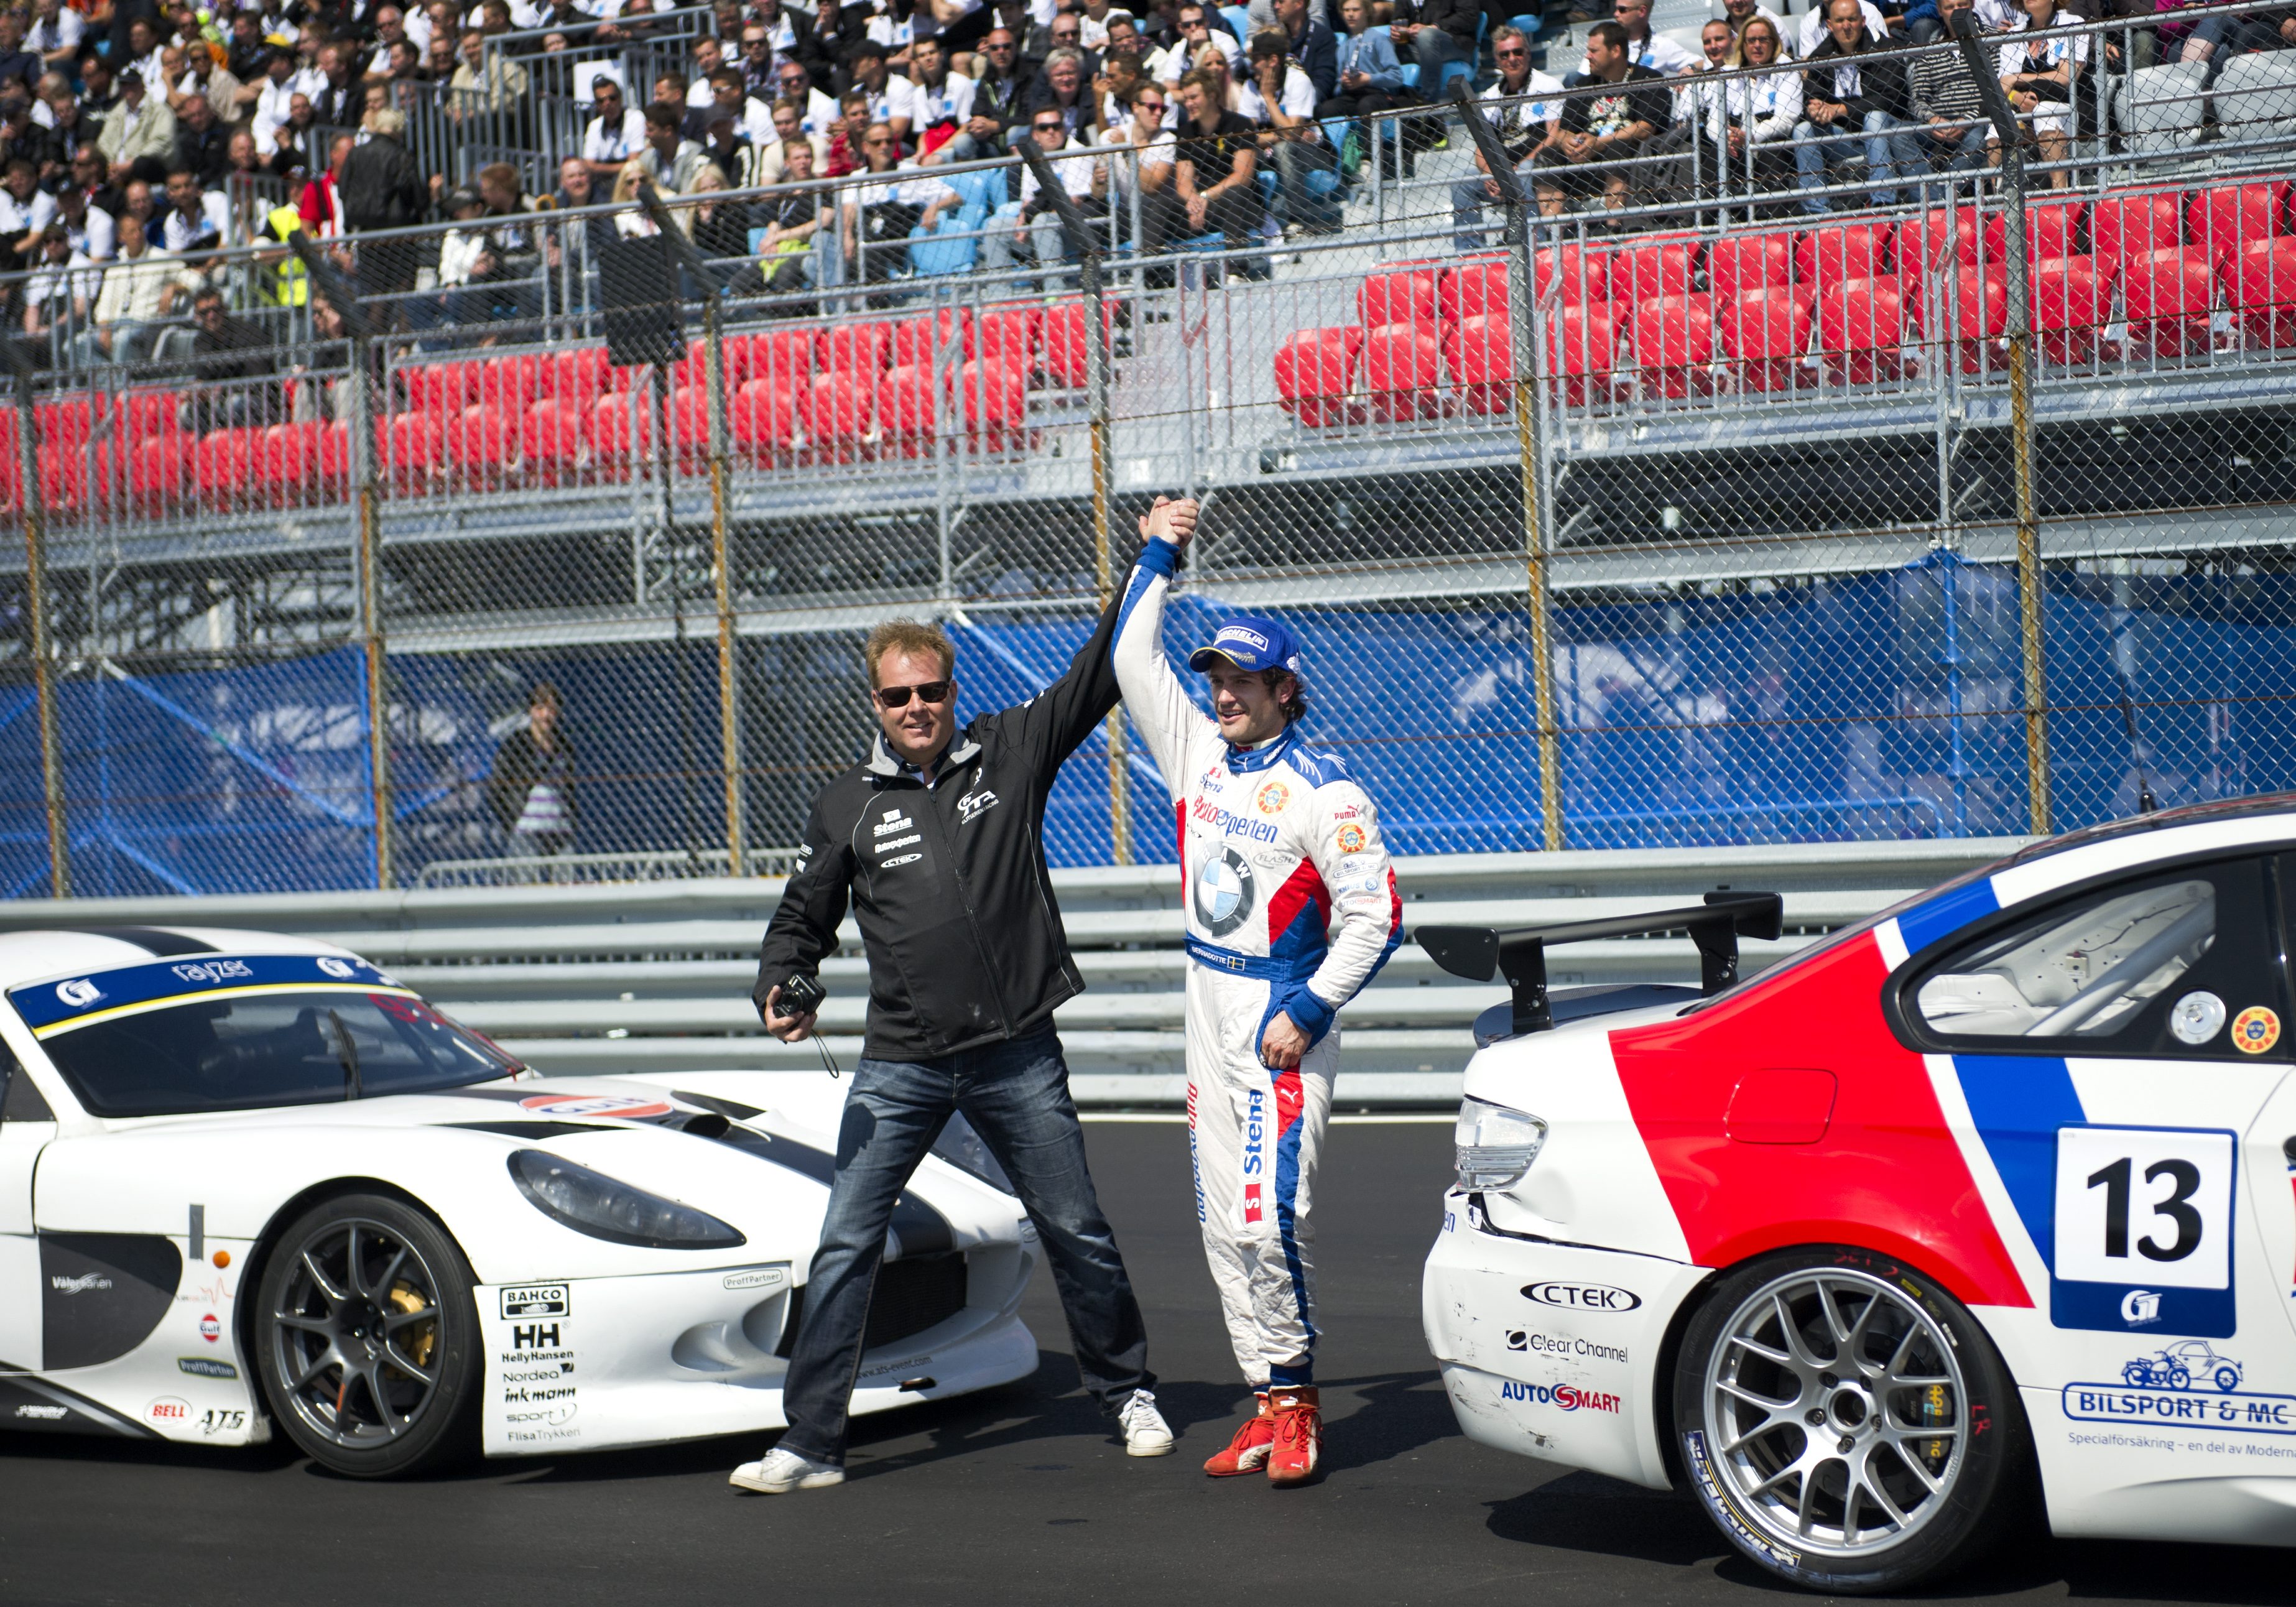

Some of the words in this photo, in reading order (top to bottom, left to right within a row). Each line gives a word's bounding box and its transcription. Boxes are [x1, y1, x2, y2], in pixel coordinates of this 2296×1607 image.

[1334, 811, 1356, 820] PUMA
[873, 817, 912, 835] Stena
[171, 960, 254, 984] rayzer
[1243, 1089, 1265, 1176] Stena
[2086, 1156, 2203, 1263] 13
[726, 1272, 780, 1287] ProffPartner
[507, 1289, 562, 1302] BAHCO
[1544, 1285, 1618, 1309] CTEK
[1530, 1333, 1572, 1353] Clear
[1575, 1338, 1629, 1364] Channel
[180, 1358, 234, 1376] ProffPartner
[502, 1369, 559, 1382] Nordea
[152, 1404, 185, 1417] BELL
[2079, 1391, 2209, 1420] BILSPORT
[2218, 1400, 2239, 1421] &
[2247, 1402, 2290, 1425] MC
[2068, 1432, 2175, 1452] Specialförsäkring
[2188, 1442, 2203, 1452] en
[2208, 1440, 2226, 1453] del
[2228, 1445, 2243, 1455] av
